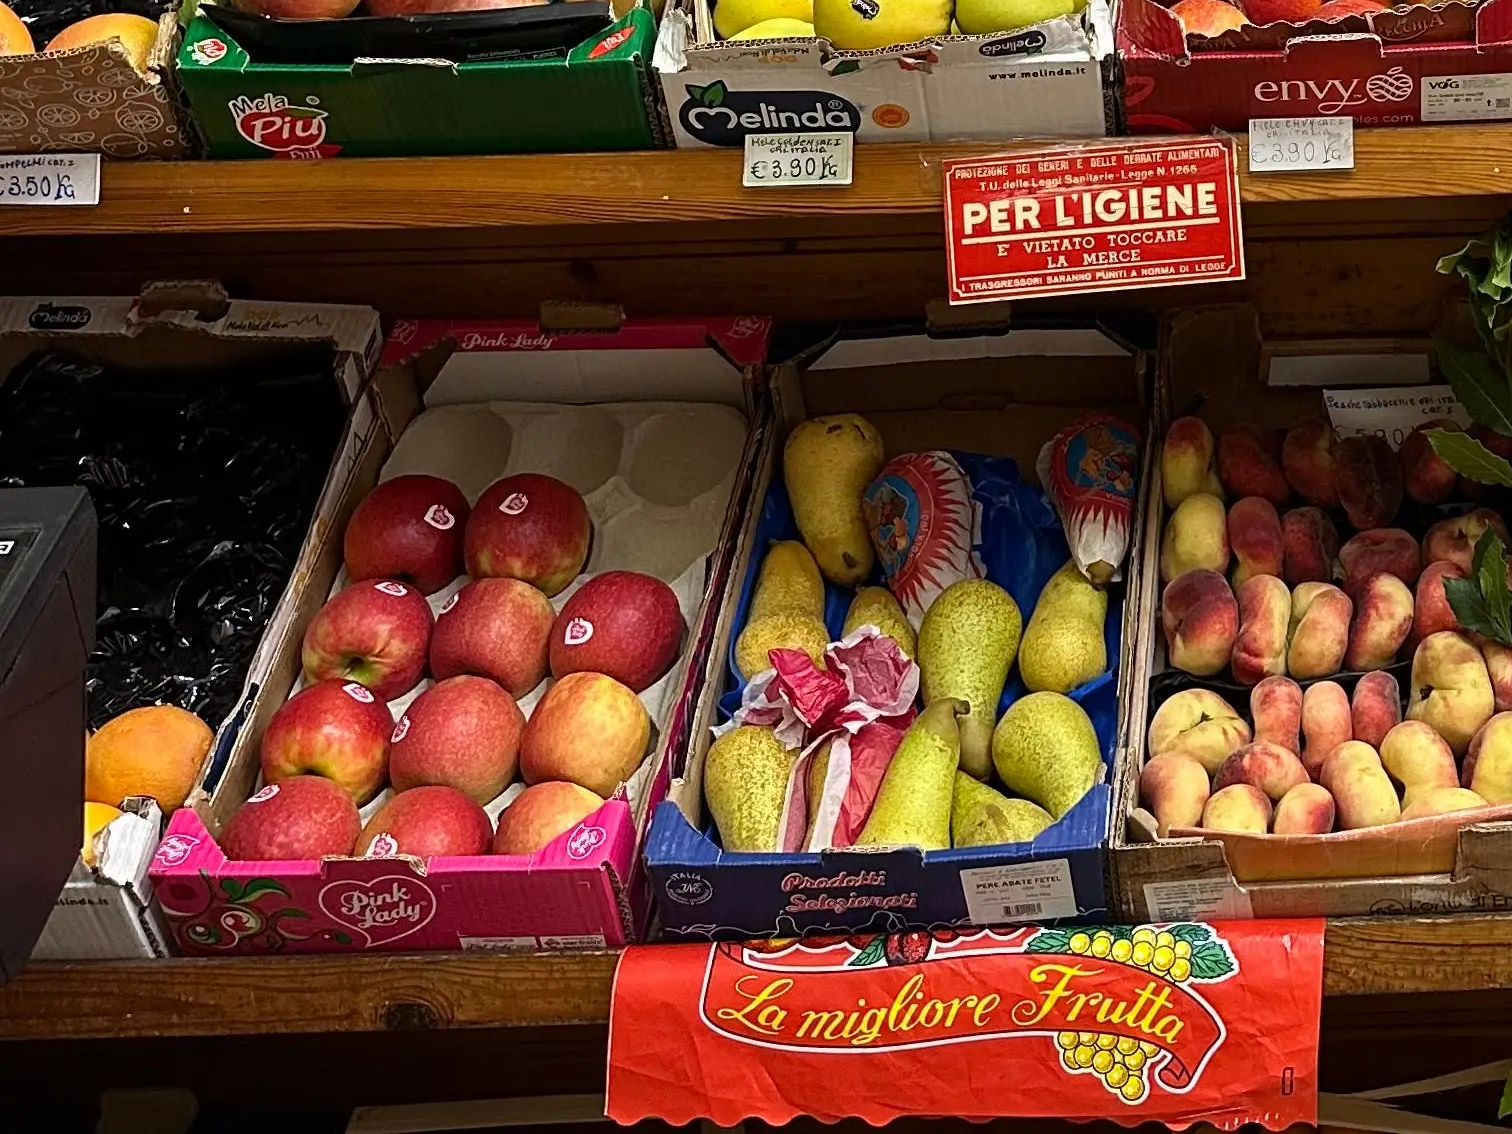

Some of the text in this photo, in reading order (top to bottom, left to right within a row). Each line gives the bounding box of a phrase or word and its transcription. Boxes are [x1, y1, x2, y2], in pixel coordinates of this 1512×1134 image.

[982, 35, 1046, 56] Melinda
[988, 66, 1087, 81] www.melinda.it
[229, 93, 288, 118] Mela
[1254, 76, 1367, 114] envy
[687, 101, 851, 131] Melinda
[954, 147, 1220, 180] PROTEZIONE DEI GENERI E DELLE DERRATE ALIMENTARI
[980, 181, 1001, 192] T.U.
[1031, 176, 1062, 189] Leggi
[1120, 169, 1155, 181] Legge
[962, 182, 1218, 236] PER L'IGIENE
[1022, 236, 1096, 255] VIETATO
[1107, 229, 1187, 248] TOCCARE
[1047, 249, 1141, 269] LA MERCE
[961, 261, 1227, 293] I TRASGRESSORI SARANNO PUNITI A NORMA DI LEGGE
[32, 310, 89, 324] Melinda
[461, 332, 555, 349] Pink Lady
[781, 871, 887, 892] Prodotti
[1034, 875, 1062, 884] FETEL
[340, 883, 421, 929] Pink Lady
[785, 892, 919, 912] Selezionati
[715, 962, 1187, 1049] La migliore Frutta
